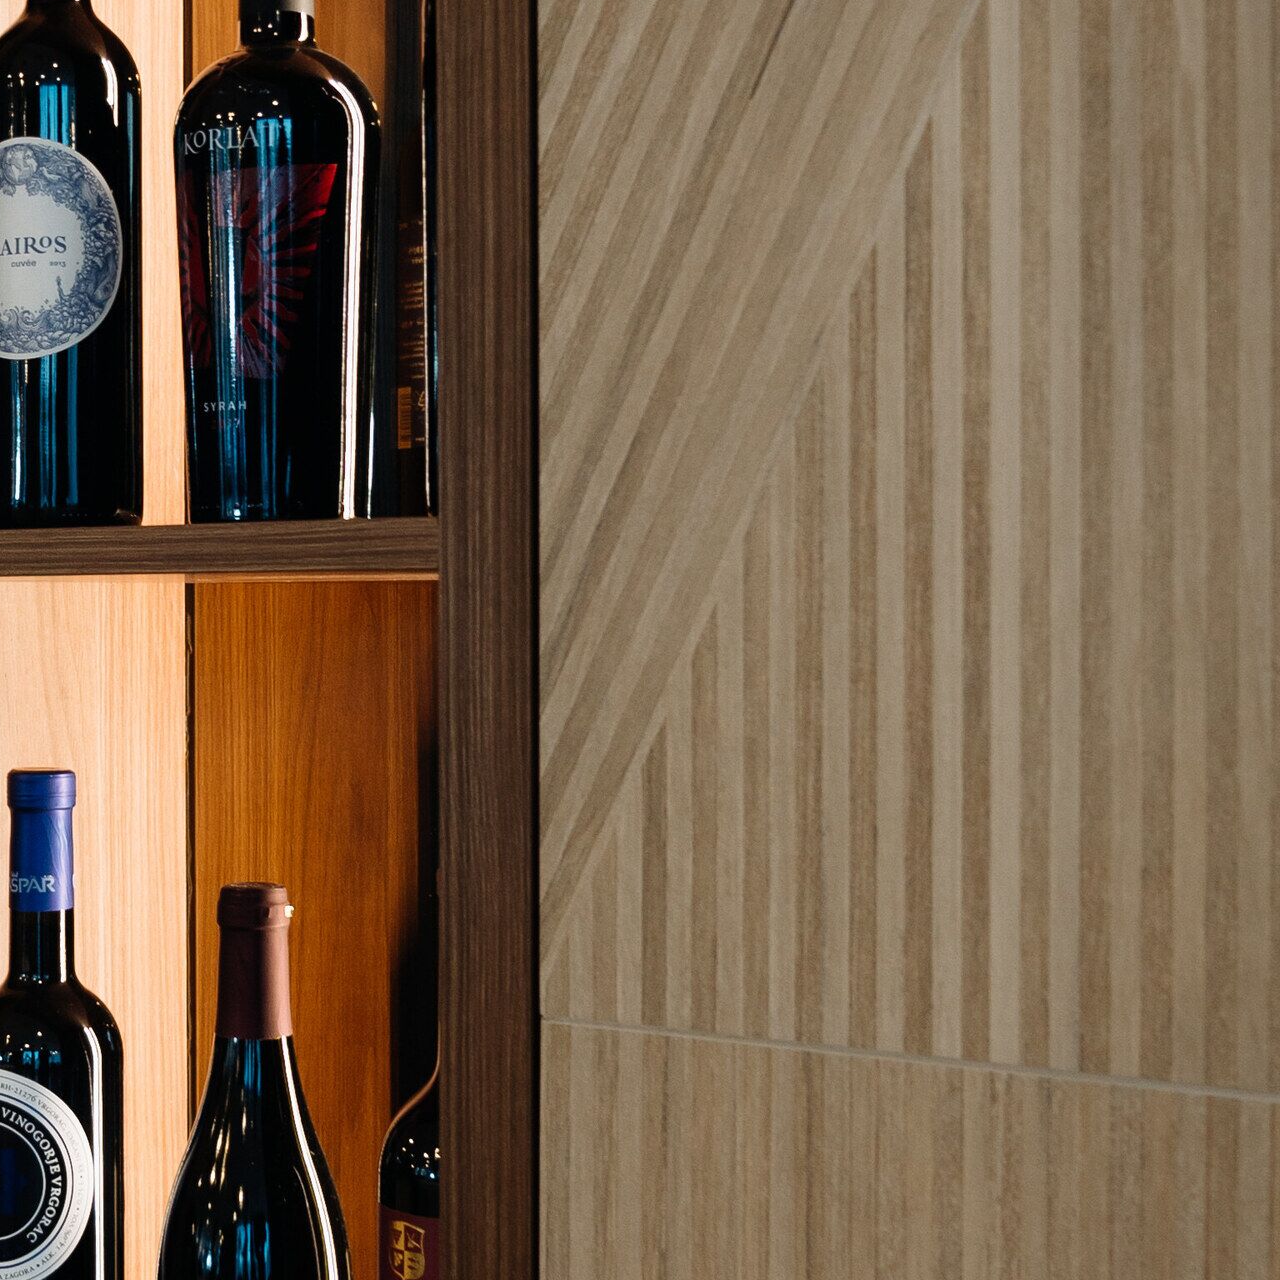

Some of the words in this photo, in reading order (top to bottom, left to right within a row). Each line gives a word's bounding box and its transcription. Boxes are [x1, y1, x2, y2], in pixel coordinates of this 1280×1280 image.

[183, 124, 283, 156] KORLAT
[10, 259, 38, 269] cuvée
[203, 400, 247, 413] SYRAH
[0, 1105, 64, 1176] VINOGORJE
[25, 1176, 62, 1244] VRGORAC
[3, 1265, 36, 1280] ZAGORA
